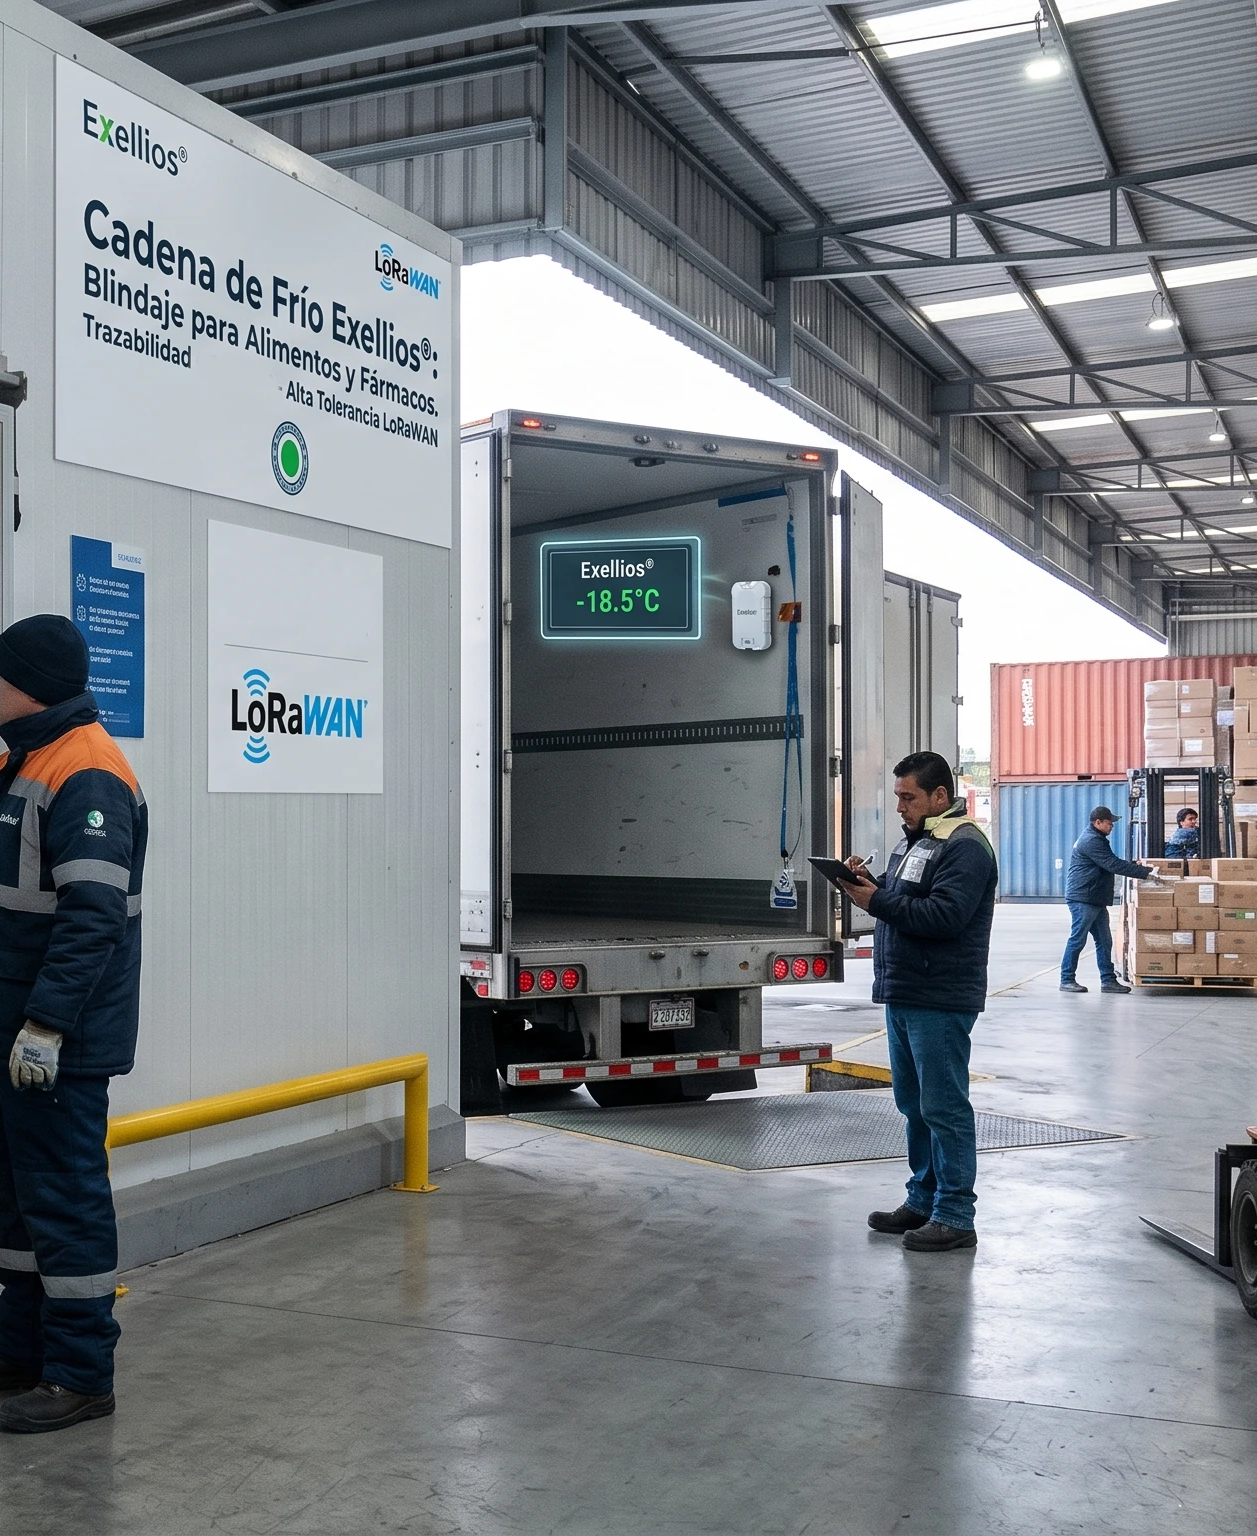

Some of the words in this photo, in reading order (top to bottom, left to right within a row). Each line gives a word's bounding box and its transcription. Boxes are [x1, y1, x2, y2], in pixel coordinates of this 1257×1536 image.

[83, 99, 188, 176] Exellios®
[84, 199, 215, 293] Cadena
[226, 260, 262, 310] de
[272, 275, 324, 334] Frío
[375, 249, 438, 300] LoRaWAN
[83, 312, 191, 369] Trazabilidad
[84, 263, 184, 331] Blindaje
[192, 310, 238, 347] para
[245, 324, 341, 383] Alimentos
[345, 366, 356, 393] y
[360, 366, 439, 417] Fármacos.
[286, 380, 313, 407] Alta
[317, 390, 379, 429] Tolerancia
[384, 412, 438, 448] LoRaWAN
[576, 588, 660, 613] -18.5°C
[231, 688, 363, 738] LoRaWAN
